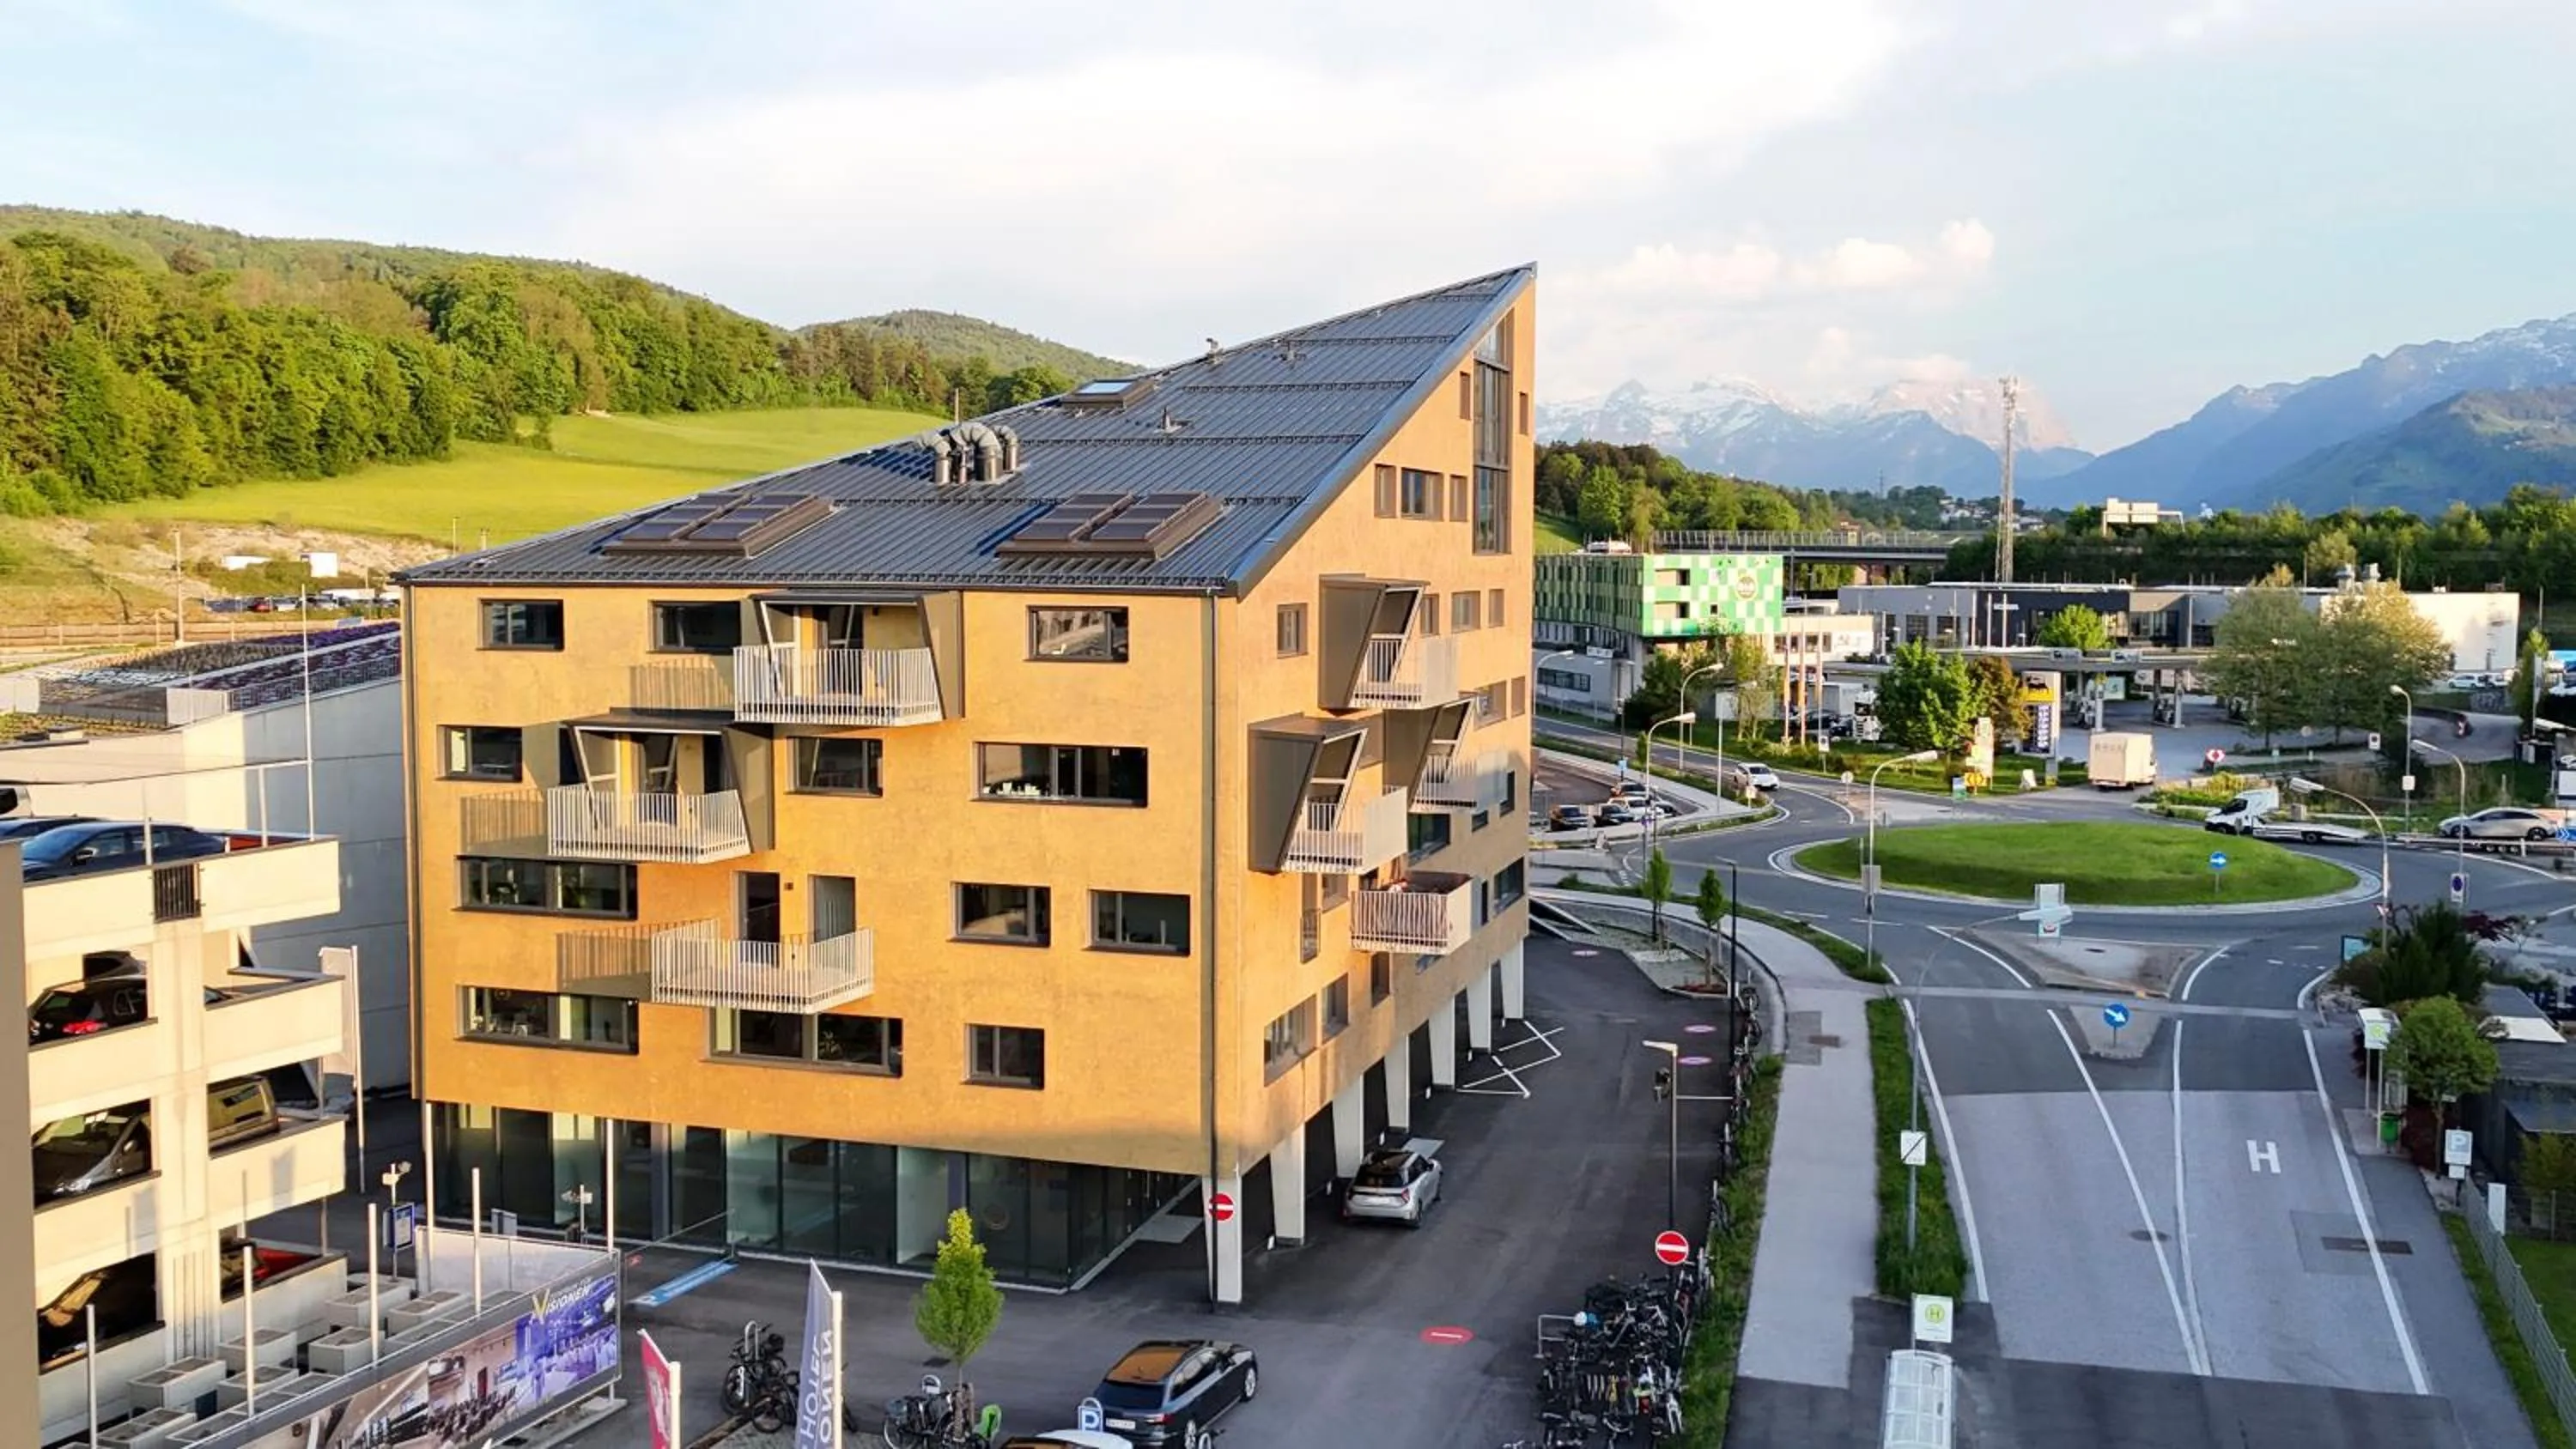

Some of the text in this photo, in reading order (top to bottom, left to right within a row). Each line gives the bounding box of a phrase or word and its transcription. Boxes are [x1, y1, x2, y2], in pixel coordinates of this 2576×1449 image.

[2451, 1135, 2467, 1150] P
[2246, 1139, 2281, 1173] H
[1082, 1410, 1099, 1433] P
